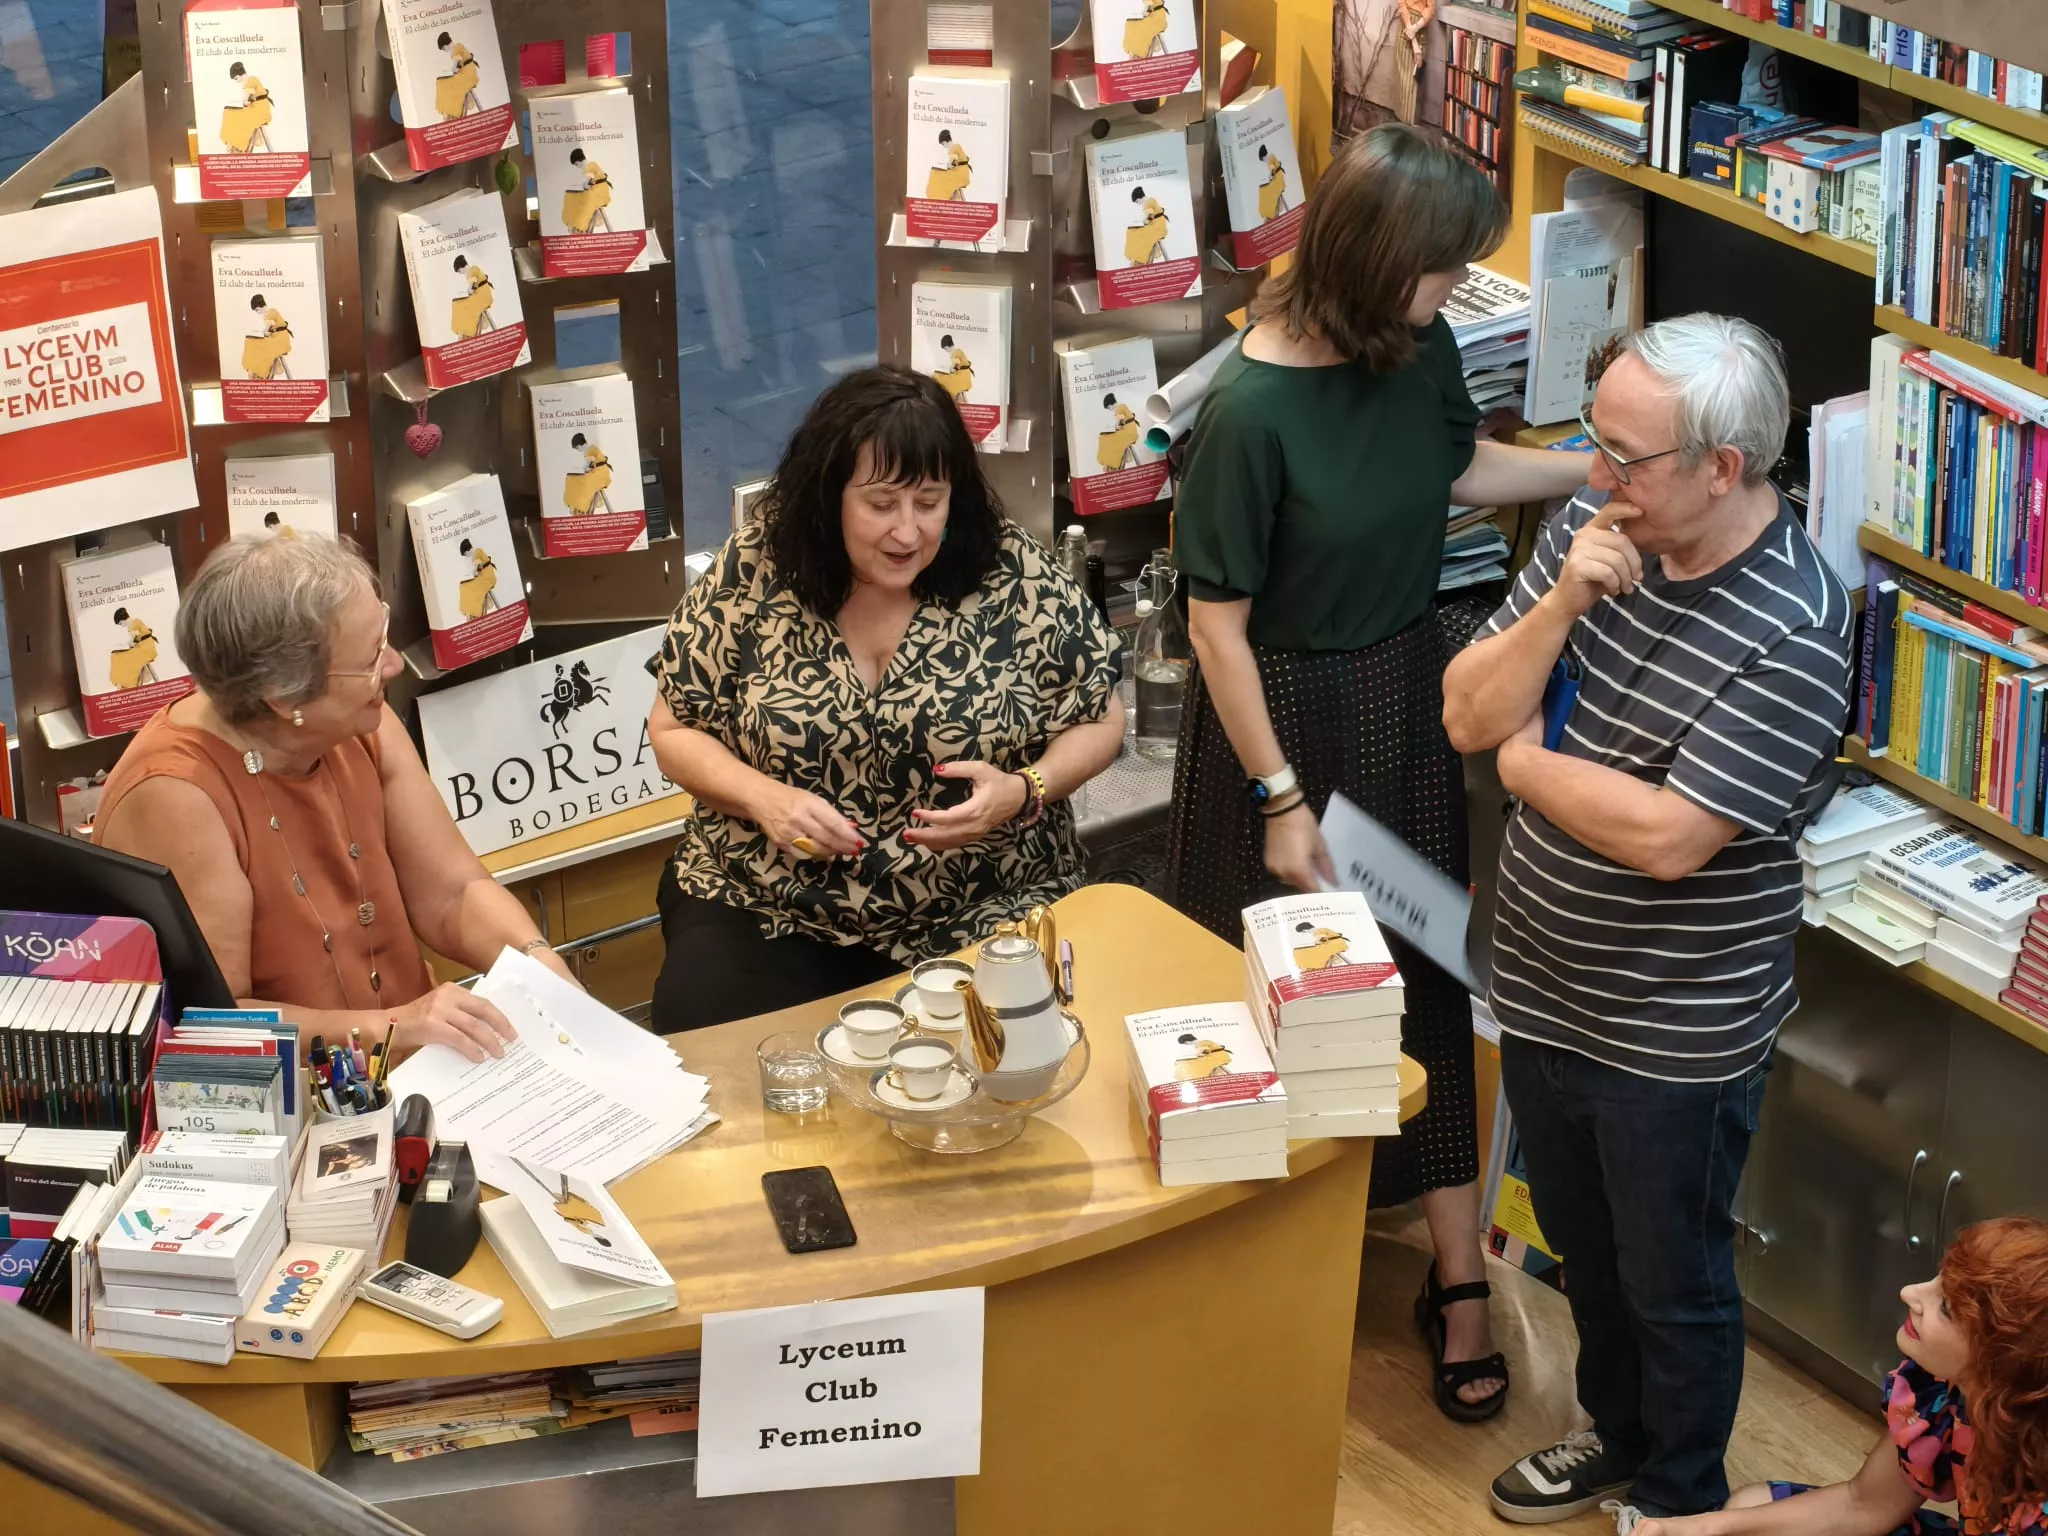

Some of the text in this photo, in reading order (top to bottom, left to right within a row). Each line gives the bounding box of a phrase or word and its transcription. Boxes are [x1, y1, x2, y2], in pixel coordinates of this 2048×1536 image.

[402, 1, 463, 22] Eva Cosculluela
[404, 8, 482, 34] El club de las modernas
[196, 33, 264, 43] Eva Cosculluela
[196, 44, 286, 56] El club de las modernas
[914, 102, 969, 114] Eva Cosculluela
[537, 121, 602, 132] Eva Cosculluela
[914, 113, 921, 121] El
[922, 114, 935, 122] club
[945, 115, 954, 123] las
[955, 116, 988, 126] modernas
[538, 131, 623, 144] El club de las modernas
[1101, 159, 1158, 175] Eva Cosculluela
[1102, 167, 1177, 186] El club de las modernas
[419, 224, 479, 246] Eva Cosculluela
[421, 230, 497, 258] El club de las modernas
[219, 267, 282, 276] Eva Cosculluela
[219, 279, 304, 288] El club de las modernas
[917, 307, 970, 320] Eva Cosculluela
[38, 320, 79, 334] Centenario
[917, 318, 988, 332] El club de las modernas
[4, 325, 119, 369] LYCEVM
[4, 354, 127, 388] 1926 CLUB 2026
[1074, 366, 1128, 382] Eva Cosculluela
[1083, 382, 1096, 391] club
[1096, 381, 1104, 389] de
[1105, 379, 1114, 388] las
[1115, 374, 1146, 386] modernas
[539, 406, 602, 419] Eva Cosculluela
[539, 415, 623, 430] El club de las modernas
[233, 486, 296, 494] Eva Cosculluela
[233, 497, 241, 505] El
[242, 497, 257, 505] club
[259, 497, 267, 505] de
[269, 497, 279, 505] las
[428, 508, 480, 533] Eva Cosculluela
[430, 513, 497, 544] El club de las modernas
[77, 578, 143, 597] Eva Cosculluela
[79, 584, 164, 608] El club de las modernas
[510, 773, 674, 839] BODEGAS
[1927, 824, 1966, 841] BONA
[1919, 846, 1948, 860] reto
[1943, 841, 1961, 852] de
[1135, 1016, 1212, 1032] Eva Cosculluela
[1149, 1029, 1166, 1037] club
[1196, 1021, 1239, 1029] modernas
[184, 1116, 215, 1132] 105
[149, 1161, 193, 1169] Sudokus
[159, 1184, 206, 1192] palabras
[154, 1242, 180, 1250] ALMA
[324, 1250, 345, 1272] MEMO
[779, 1337, 906, 1368] Lyceum
[805, 1377, 878, 1402] Club
[758, 1418, 922, 1450] Femenino
